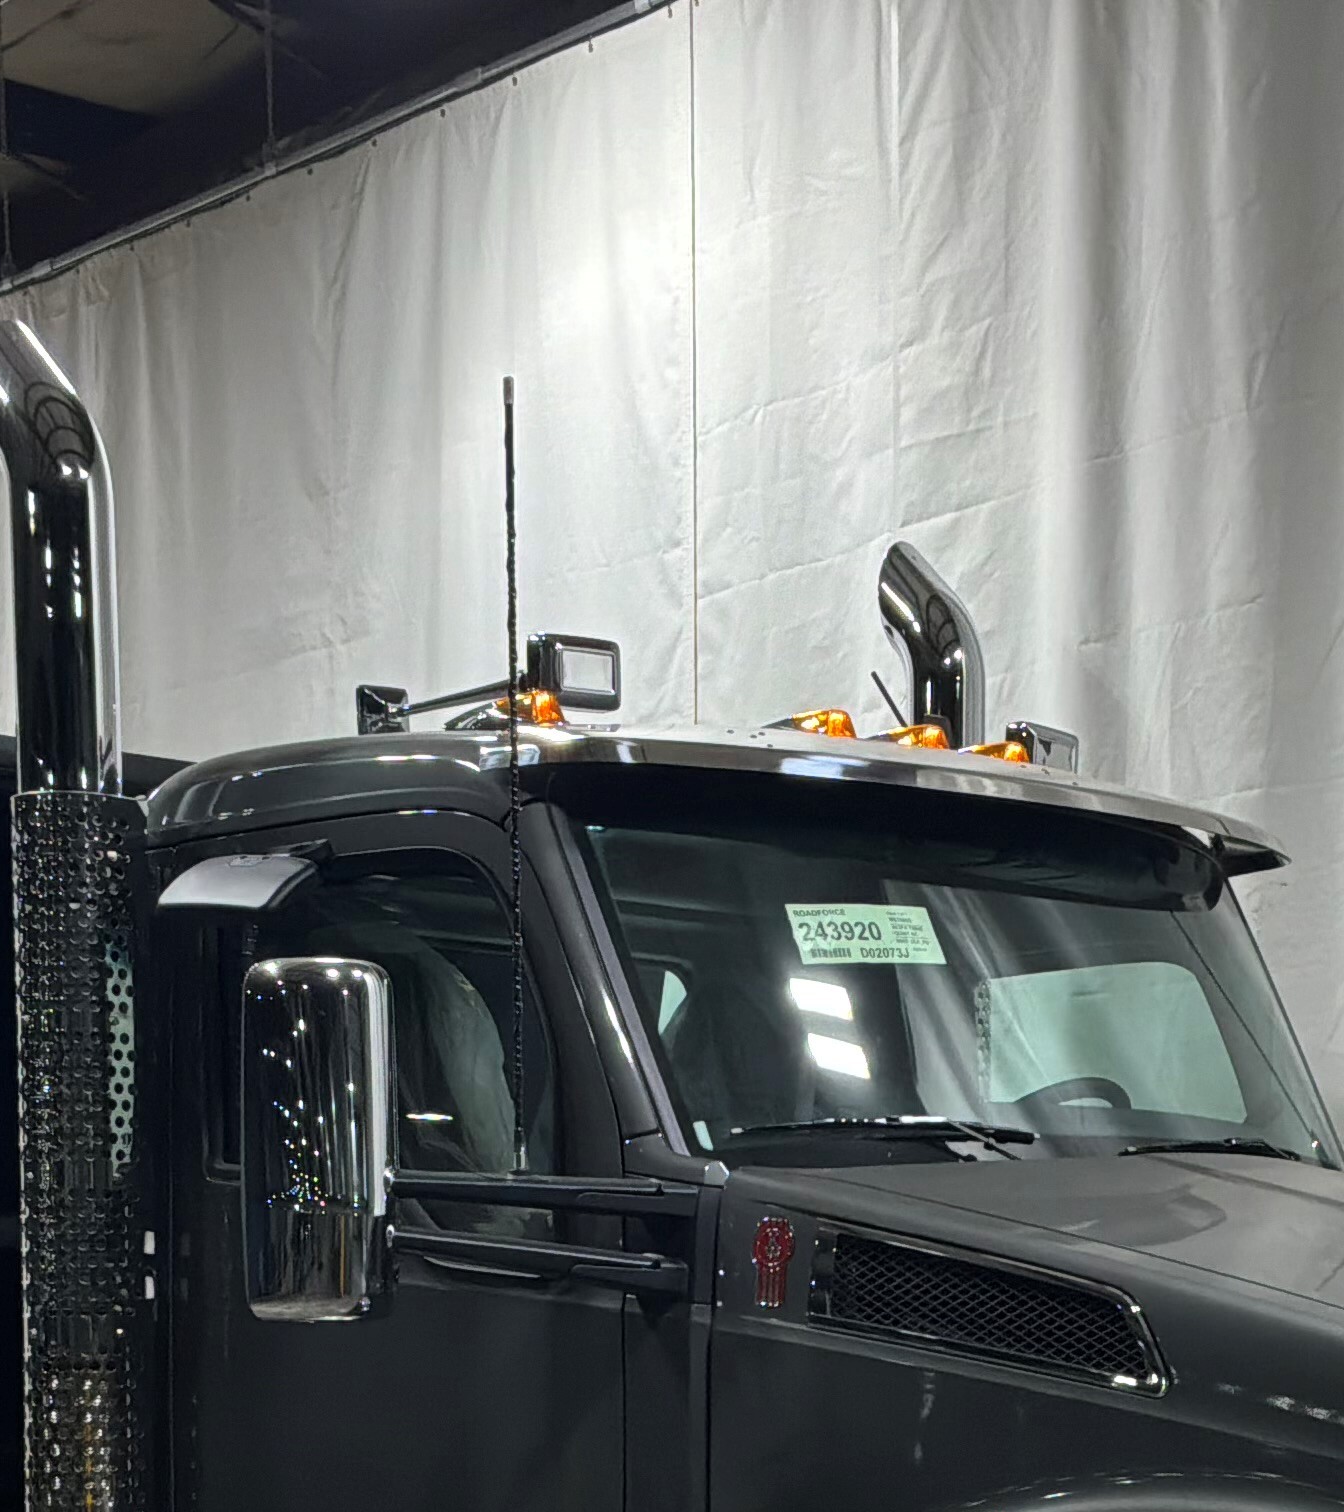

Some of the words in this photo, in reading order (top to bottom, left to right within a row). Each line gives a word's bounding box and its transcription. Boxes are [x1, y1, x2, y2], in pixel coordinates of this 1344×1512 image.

[793, 908, 846, 917] ROADFORCE
[798, 921, 882, 942] 243920
[860, 947, 910, 959] D02073J
